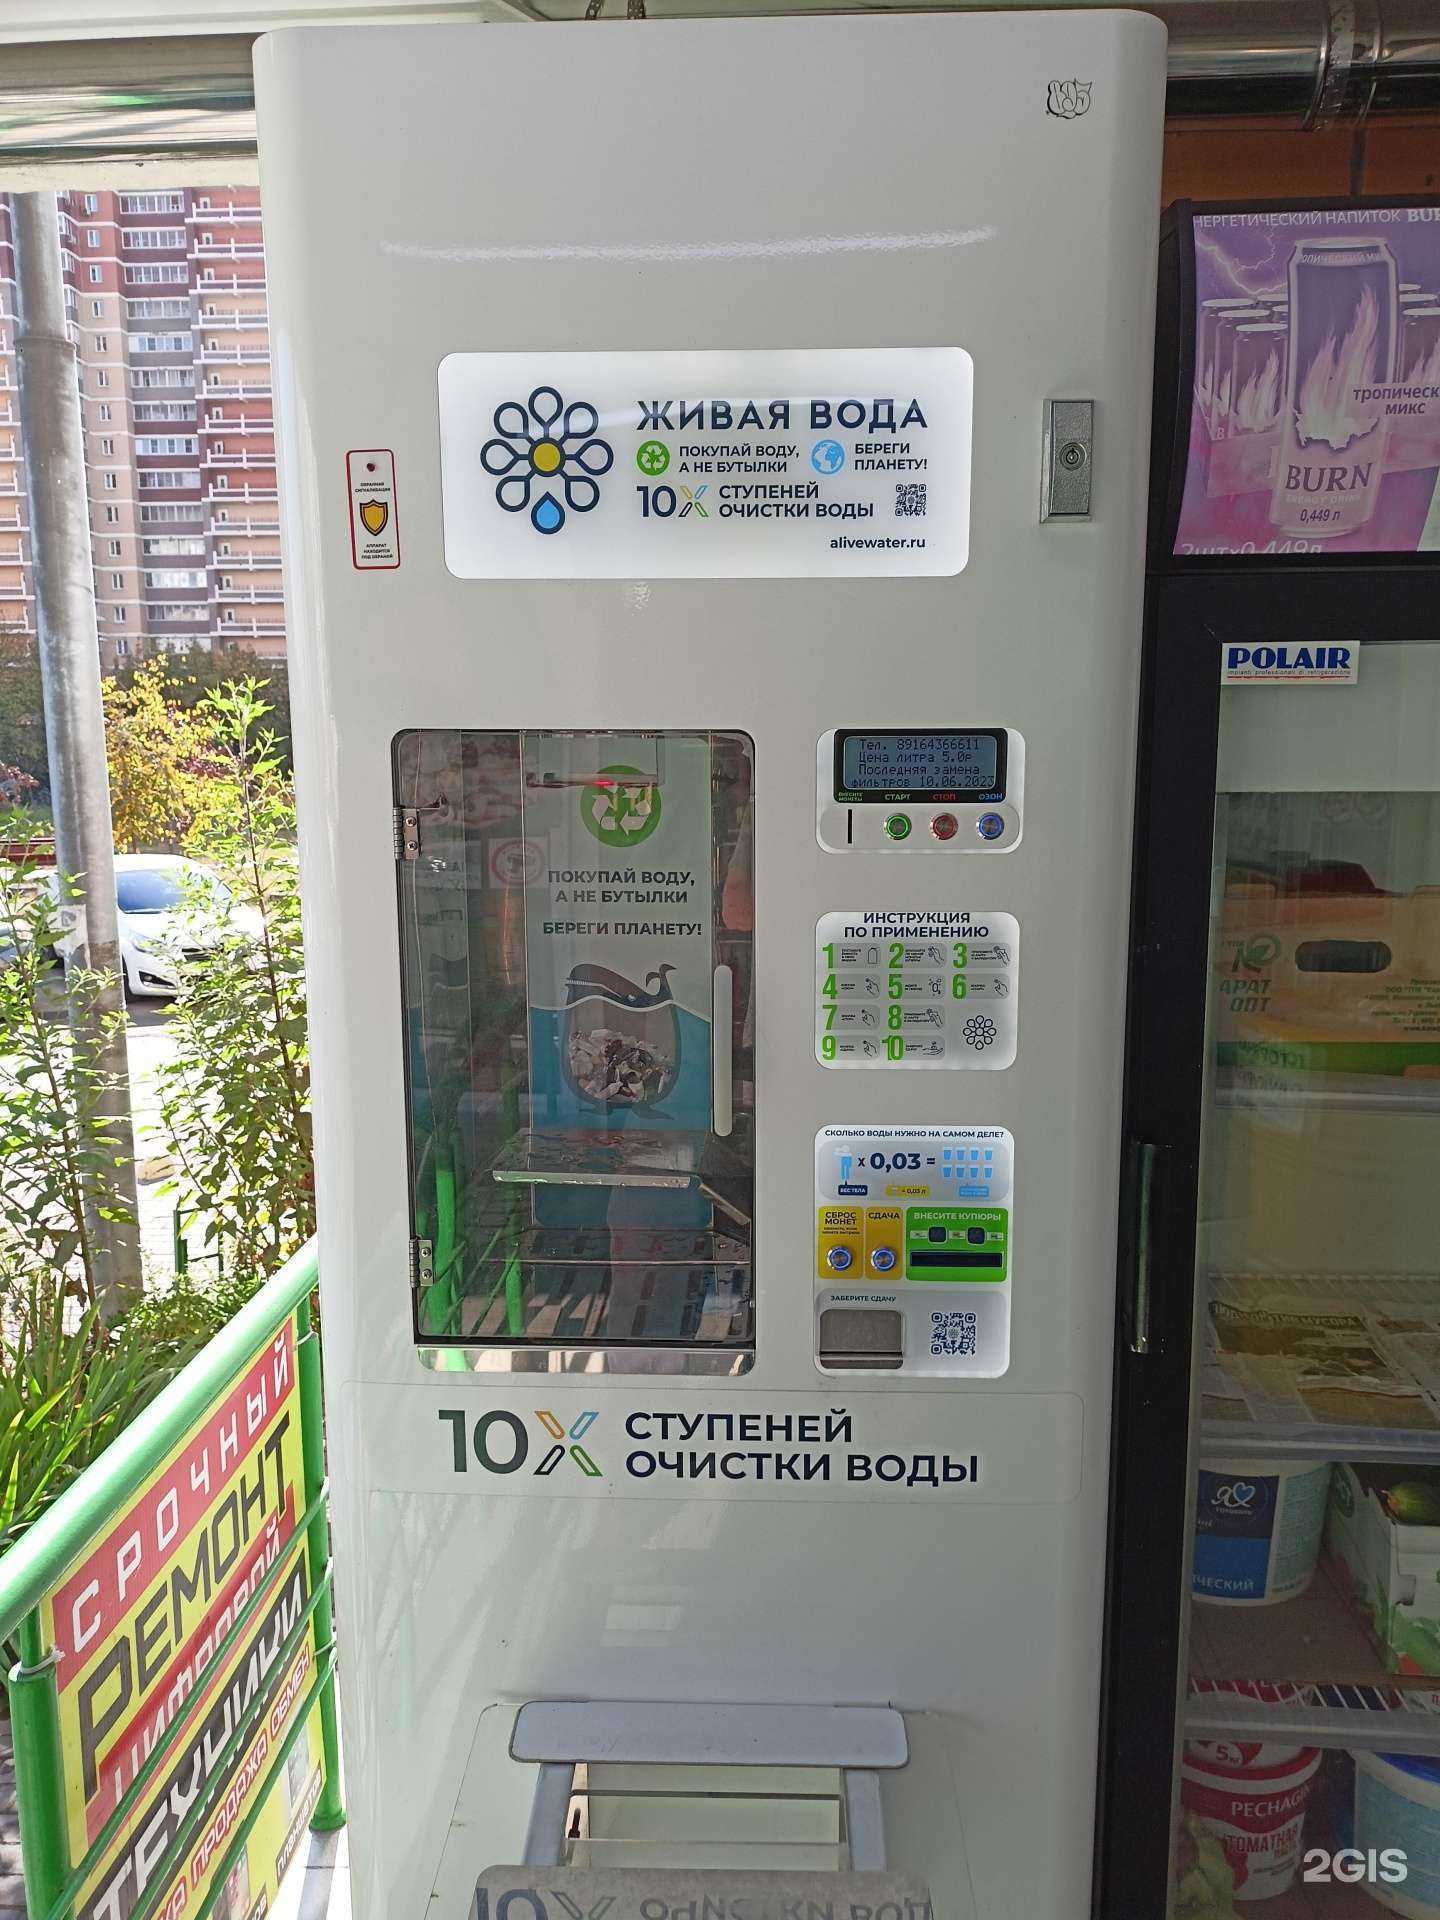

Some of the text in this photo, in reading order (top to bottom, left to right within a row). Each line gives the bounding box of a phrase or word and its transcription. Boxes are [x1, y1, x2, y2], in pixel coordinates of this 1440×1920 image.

[1326, 210, 1400, 225] НАПИТОК
[637, 399, 928, 433] ЖИВАЯ ВОДА
[1385, 402, 1426, 415] микс
[679, 442, 800, 460] ПОКУПАЙ ВОДУ,
[855, 443, 911, 455] БЕРЕГИ
[679, 461, 788, 474] А НЕ БУТЫЛКИ
[854, 458, 928, 471] ПЛАНЕТУ!
[1286, 463, 1373, 492] BURN
[719, 481, 820, 500] СТУПЕНЕЙ
[719, 503, 874, 520] ОЧИСТКИ ВОДЫ
[1300, 508, 1330, 523] 0,449
[829, 536, 926, 550] alivewater.ru
[1227, 647, 1351, 669] POLAIR
[859, 739, 888, 750] Тел.
[859, 751, 889, 764] Цена
[896, 752, 935, 763] литра
[858, 764, 980, 776] Последняя замена
[850, 777, 911, 788] фильтров
[548, 868, 695, 887] ПОКУПАЙ ВОДУ,
[555, 890, 688, 903] А НЕ БУТЫЛКИ
[863, 912, 970, 926] ИНСТРУКЦИЯ
[543, 922, 702, 936] БЕРЕГИ ПЛАНЕТУ!
[844, 926, 989, 938] ПО ПРИМЕНЕНИЮ
[822, 943, 835, 969] 1
[888, 943, 904, 969] 2
[953, 943, 967, 969] 3
[822, 974, 838, 1000] 4
[888, 974, 903, 1000] 5
[952, 974, 967, 1000] 6
[822, 1004, 838, 1030] 7
[888, 1004, 902, 1030] 8
[822, 1035, 836, 1061] 9
[882, 1035, 904, 1061] 10
[825, 1129, 1004, 1140] СКОЛЬКО ВОДЫ НУЖНО НА САМОМ ДЕЛЕ?
[870, 1152, 921, 1174] 0,03
[825, 1211, 857, 1219] СБРОС
[868, 1212, 900, 1221] СДАЧА
[913, 1212, 1001, 1222] ВНЕСИТЕ КУПЮРЫ
[871, 1295, 897, 1303] СДАЧУ
[625, 1408, 853, 1443] СТУПЕНЕЙ
[625, 1450, 978, 1487] ОЧИСТКИ ВОДЫ
[72, 1331, 289, 1656] СРОЧНЫЙ
[77, 1410, 290, 1799] РЕМОНТ
[190, 1641, 310, 1892] ПРОДАЖА ОБМЕН
